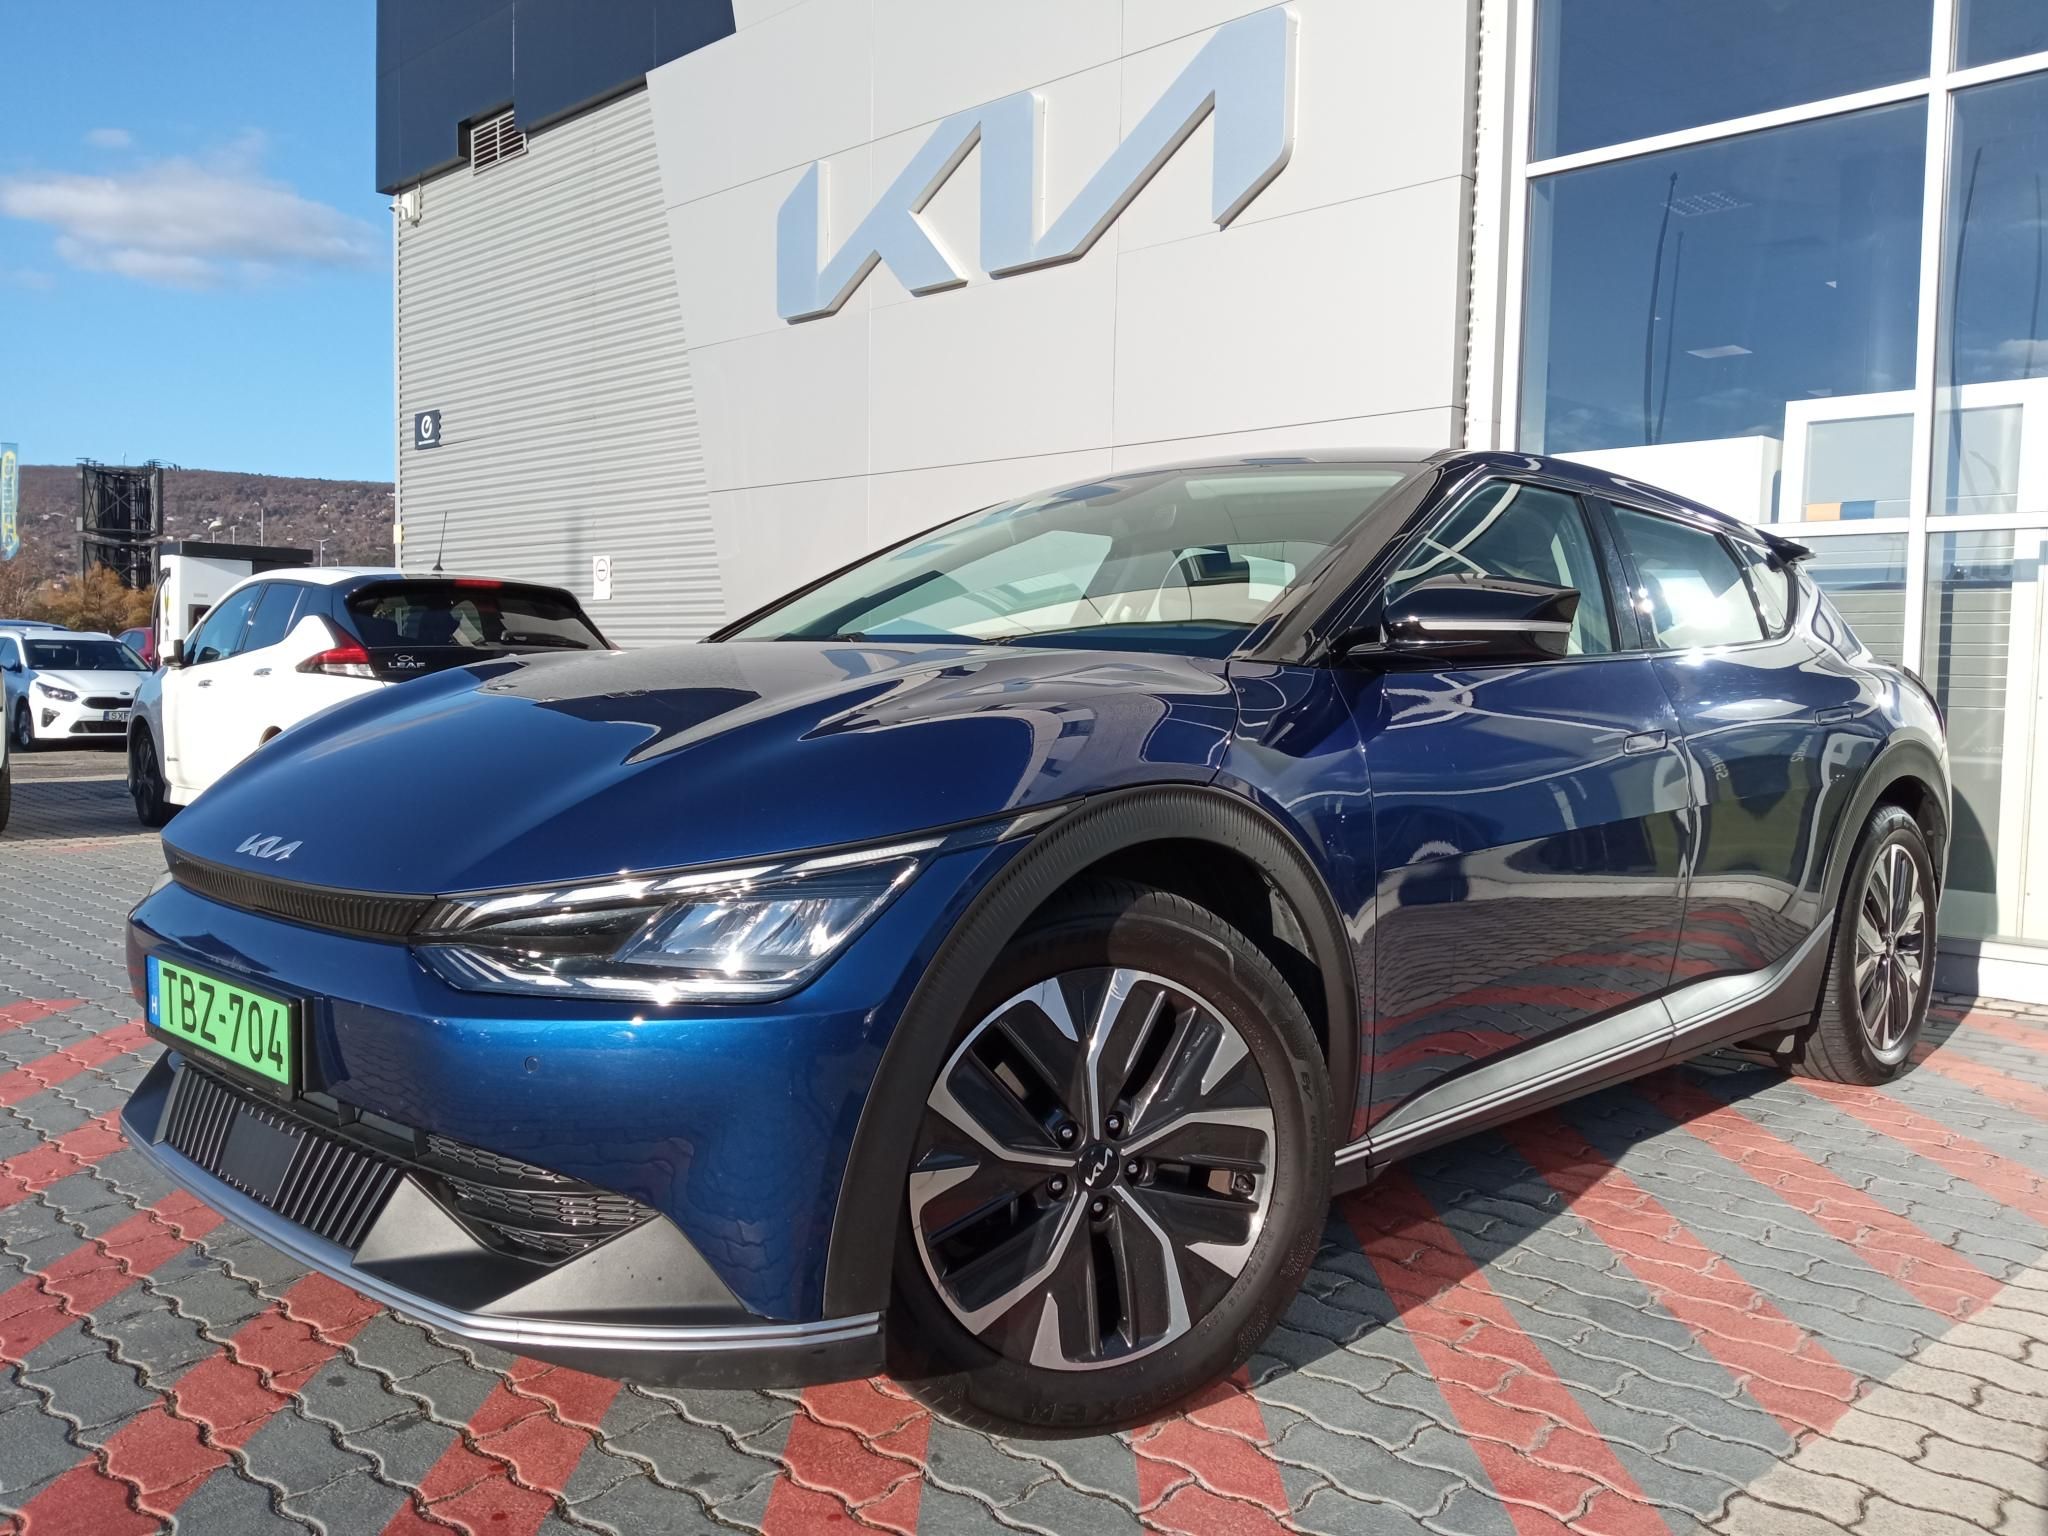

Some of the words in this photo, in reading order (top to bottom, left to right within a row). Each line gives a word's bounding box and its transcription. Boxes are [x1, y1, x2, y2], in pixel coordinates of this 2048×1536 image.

[777, 6, 1300, 324] KIA
[388, 661, 426, 669] LEAF
[235, 832, 304, 862] KIA
[162, 967, 284, 1073] TBZ-704
[1085, 1147, 1112, 1187] KIA
